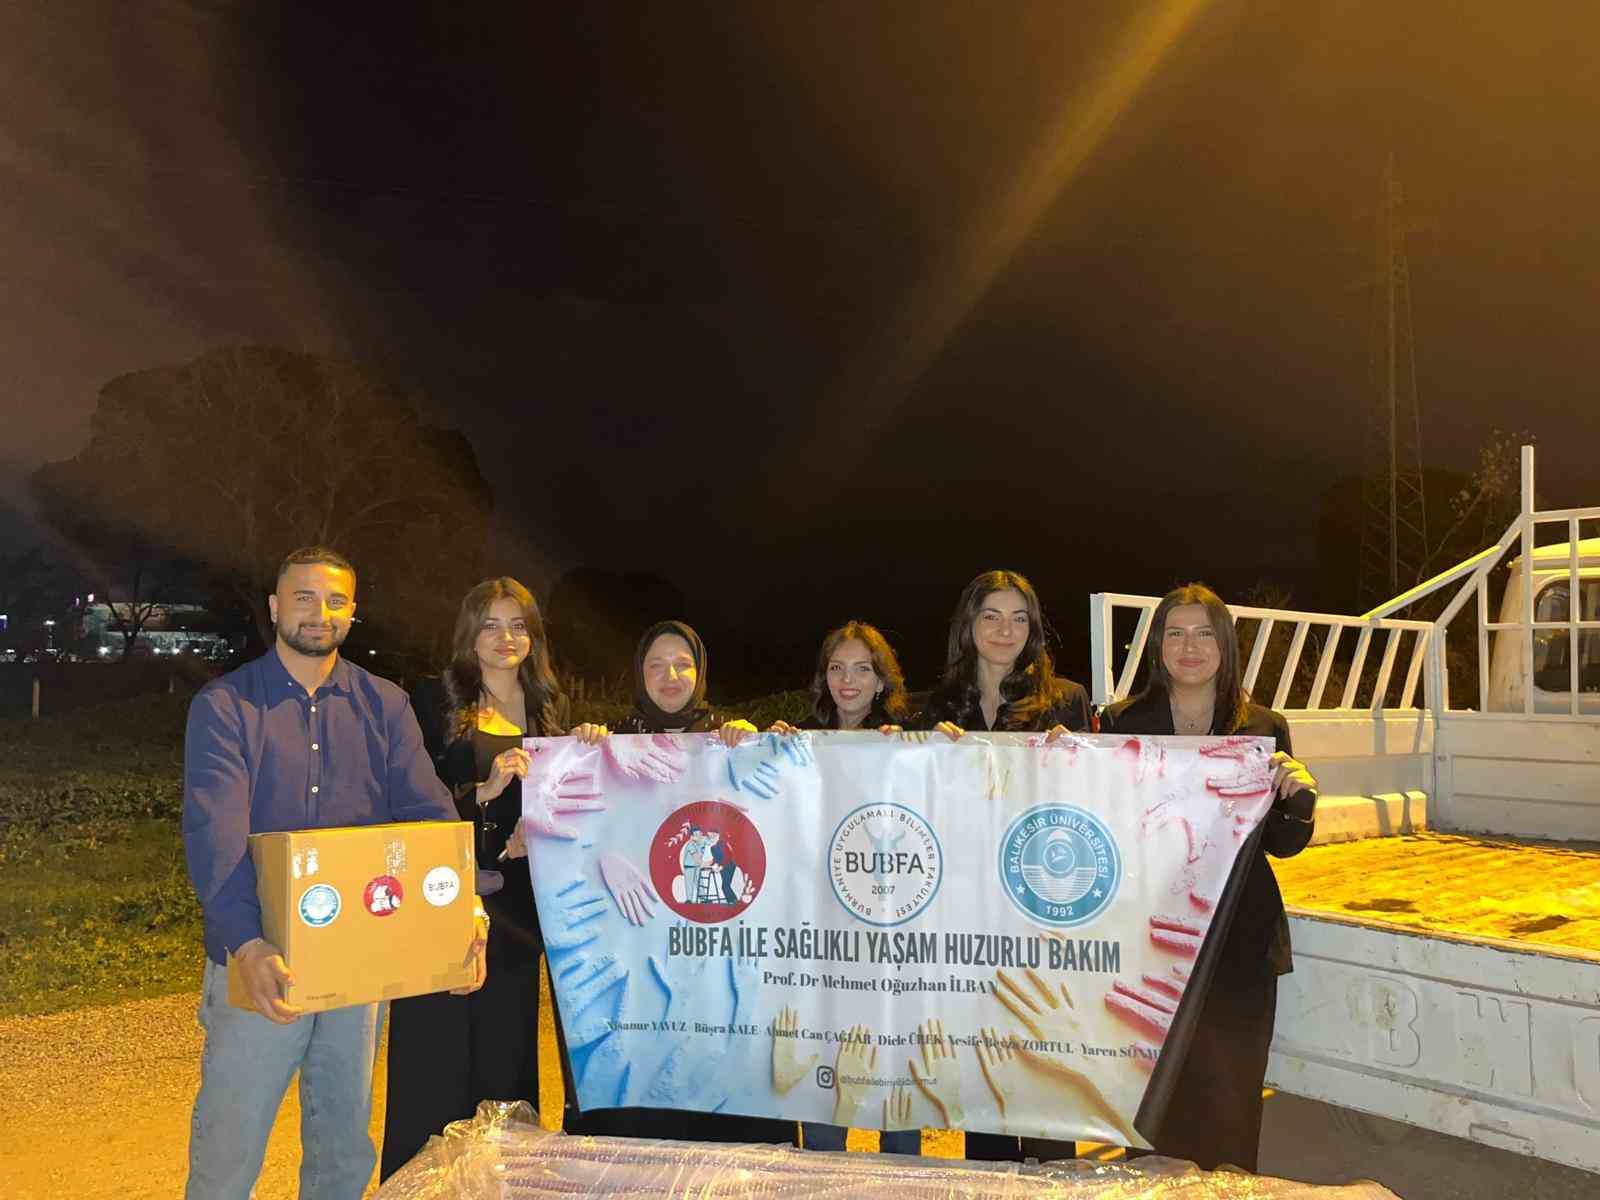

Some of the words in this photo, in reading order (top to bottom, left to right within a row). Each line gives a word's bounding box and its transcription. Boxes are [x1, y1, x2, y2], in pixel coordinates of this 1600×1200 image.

[845, 852, 925, 874] BUBFA
[871, 885, 896, 895] 2007
[1046, 904, 1074, 917] 1992
[669, 926, 732, 957] BUBFA
[738, 920, 768, 958] İLE
[774, 922, 859, 962] SAĞLIKLI
[866, 931, 937, 971] YAŞAM
[945, 932, 1041, 969] HUZURLU
[1049, 938, 1121, 973] BAKIM
[763, 971, 796, 986] Prof.
[800, 973, 819, 987] Dr
[822, 974, 876, 991] Mehmet
[881, 977, 946, 996] Oğuzhan
[950, 975, 998, 994] İLBAN
[652, 1020, 687, 1033] YAVUZ
[694, 1022, 726, 1037] Büşra
[727, 1023, 760, 1036] KALE
[801, 1028, 823, 1041] Can
[1023, 1039, 1074, 1054] ZORTUL
[1081, 1042, 1117, 1057] Yaren
